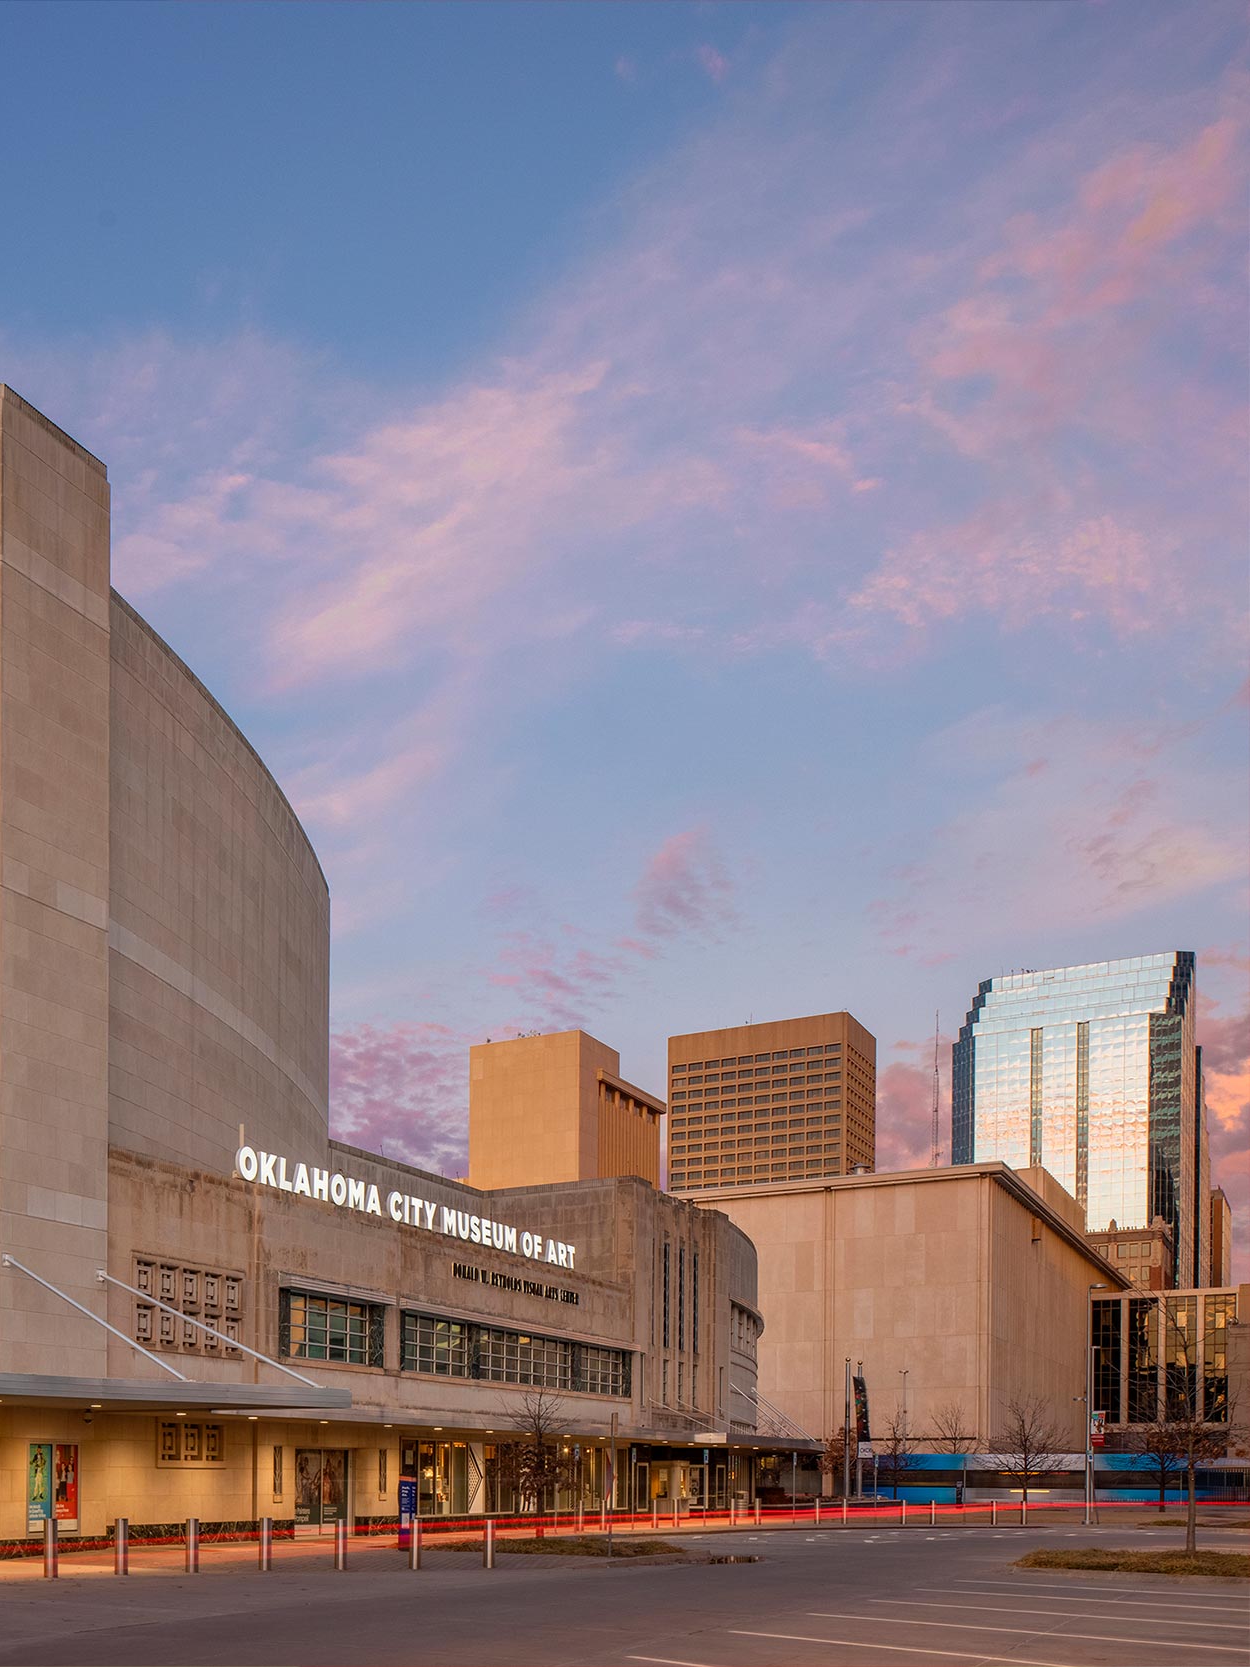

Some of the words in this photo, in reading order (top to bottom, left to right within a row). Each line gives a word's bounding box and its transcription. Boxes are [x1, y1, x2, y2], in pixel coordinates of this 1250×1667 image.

[236, 1146, 382, 1217] OKLAHOMA
[387, 1191, 437, 1230] CITY
[440, 1206, 517, 1254] MUSEUM
[520, 1231, 543, 1260] OF
[546, 1239, 576, 1269] ART
[452, 1262, 479, 1282] DONALD
